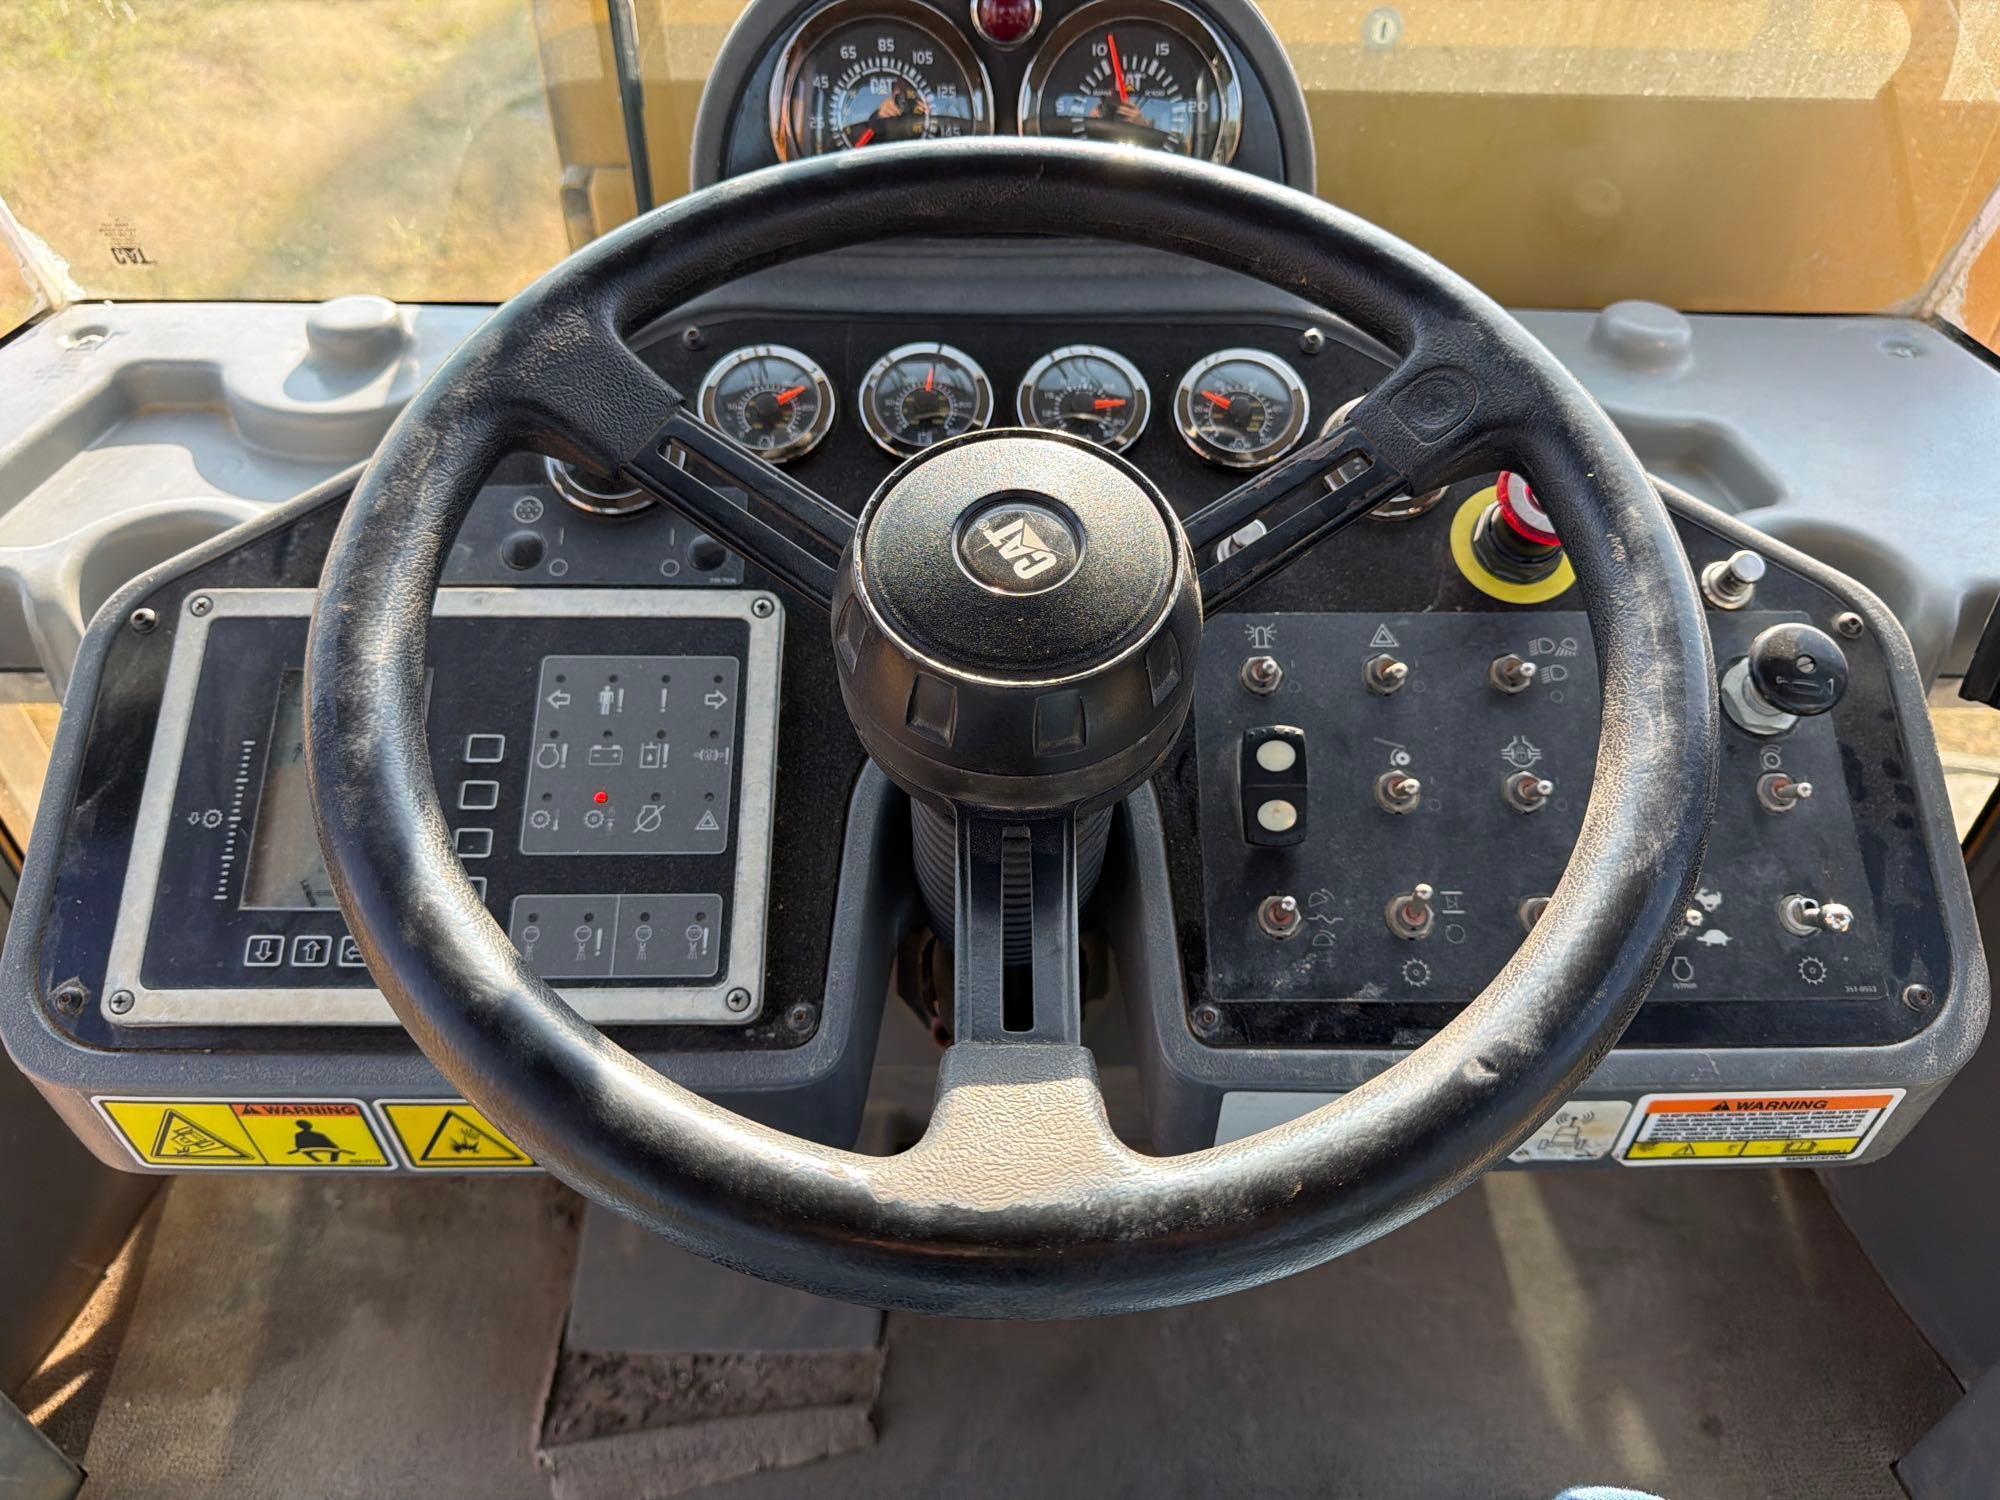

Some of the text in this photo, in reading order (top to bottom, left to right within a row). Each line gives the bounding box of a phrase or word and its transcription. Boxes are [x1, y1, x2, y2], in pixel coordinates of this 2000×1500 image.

[878, 39, 895, 52] 85
[1092, 43, 1108, 57] 10
[1155, 43, 1170, 56] 15
[840, 46, 857, 60] 65
[912, 51, 933, 65] 105
[813, 76, 829, 89] 45
[870, 78, 893, 94] CAT
[1115, 73, 1142, 91] AT
[937, 85, 957, 98] 125
[1055, 101, 1065, 113] 5
[1188, 101, 1208, 113] 20
[809, 117, 825, 129] 25
[983, 517, 1057, 580] CAT
[262, 1104, 356, 1116] WARNING
[1736, 1099, 1829, 1111] WARNING
